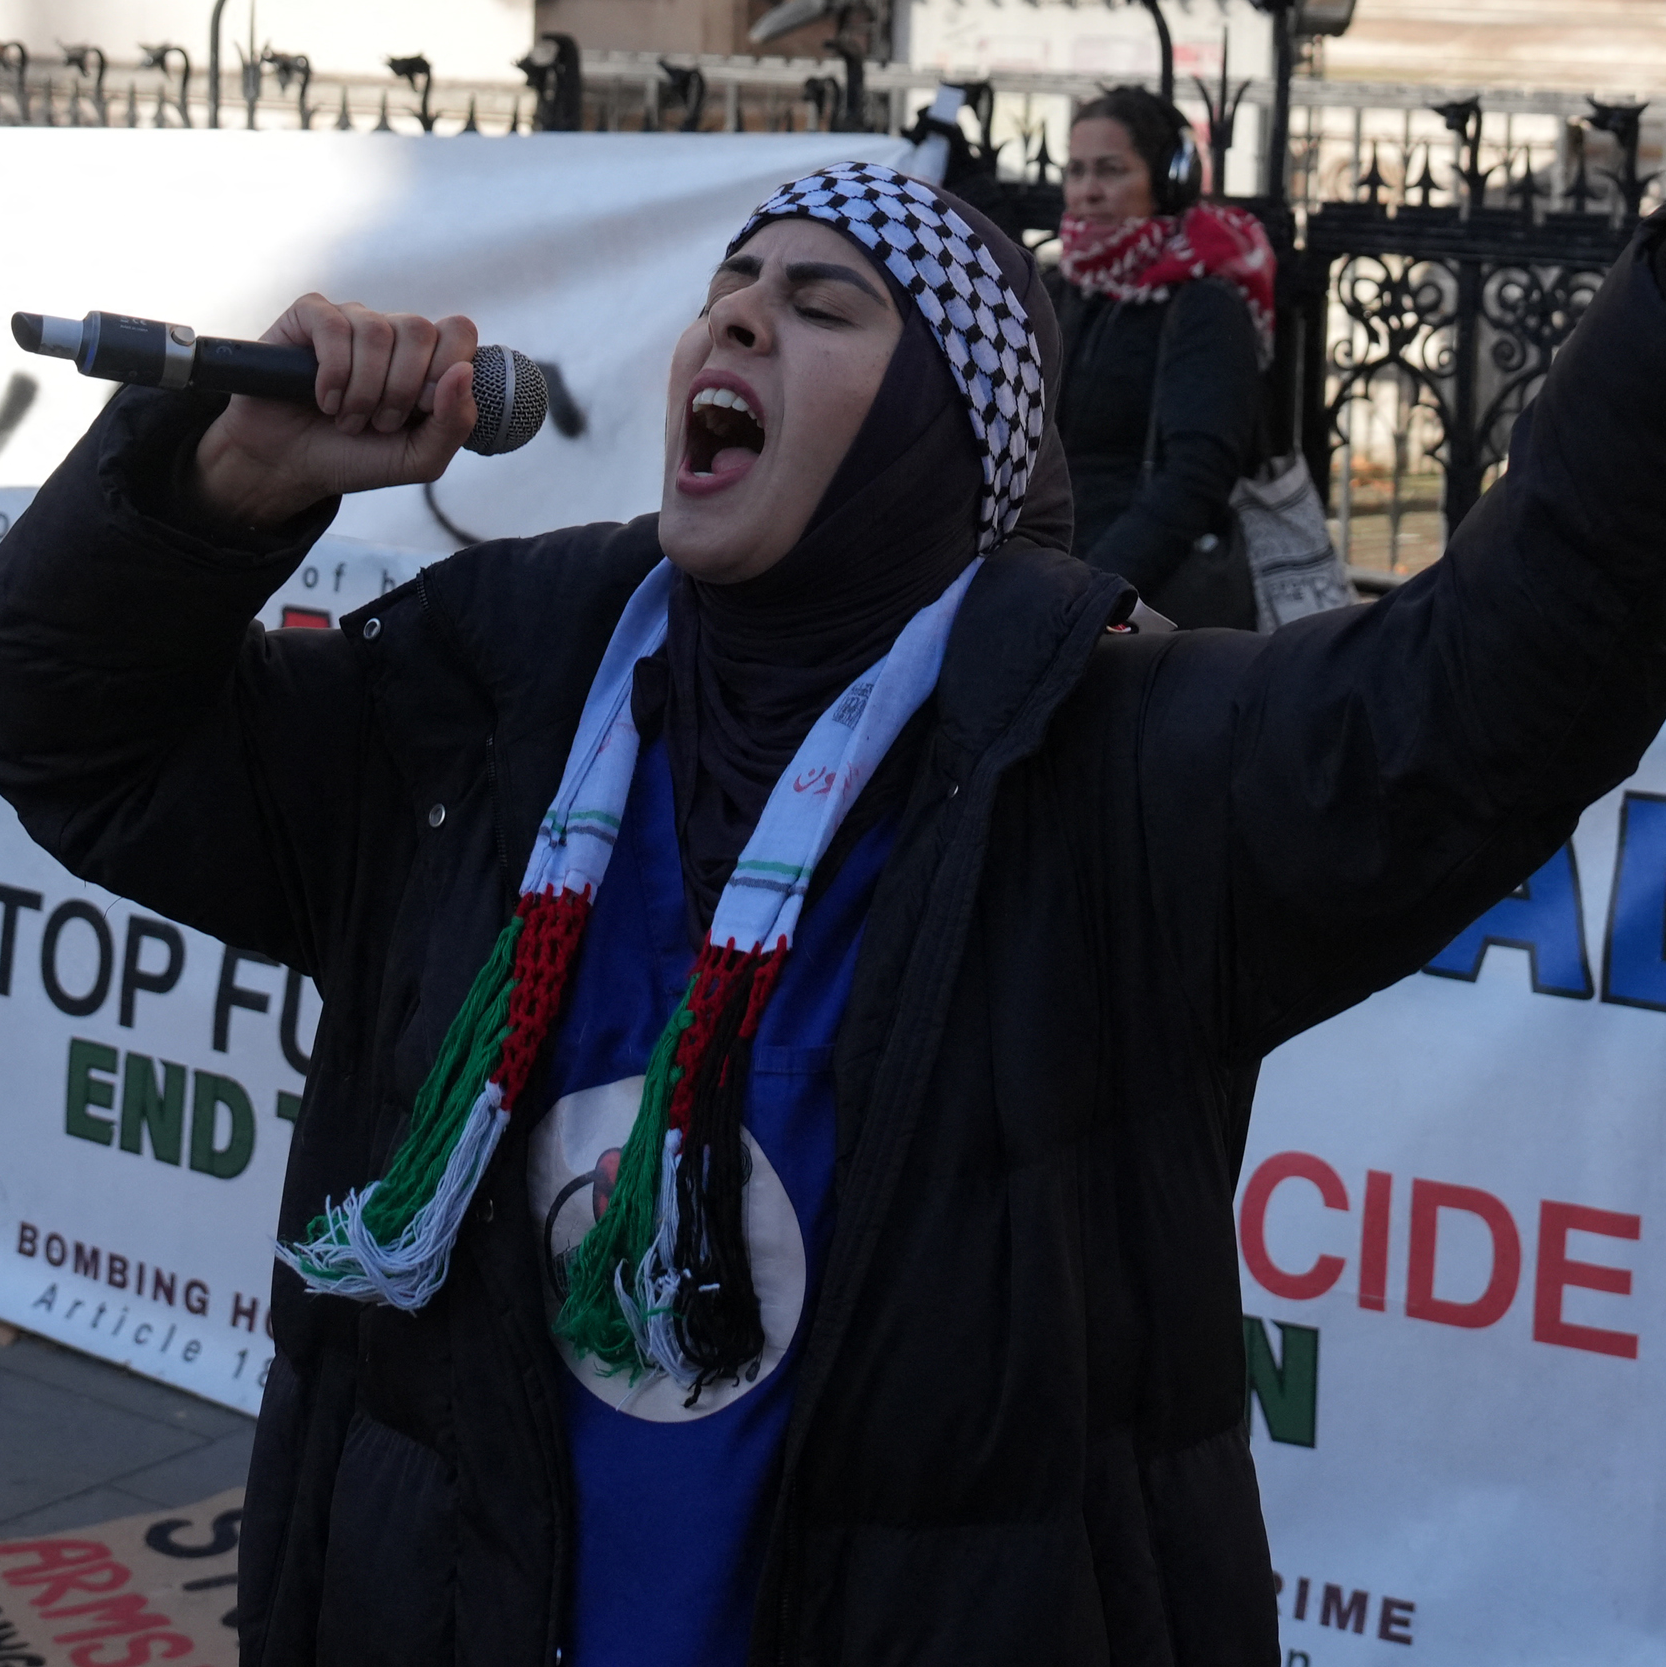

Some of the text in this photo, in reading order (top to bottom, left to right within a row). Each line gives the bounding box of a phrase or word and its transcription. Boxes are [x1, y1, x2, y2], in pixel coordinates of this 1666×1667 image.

[65, 1036, 257, 1181] END
[17, 1220, 211, 1318] BOMBING
[1239, 1149, 1643, 1361] CIDE
[31, 1282, 204, 1363] Article
[1273, 1569, 1417, 1646] IME
